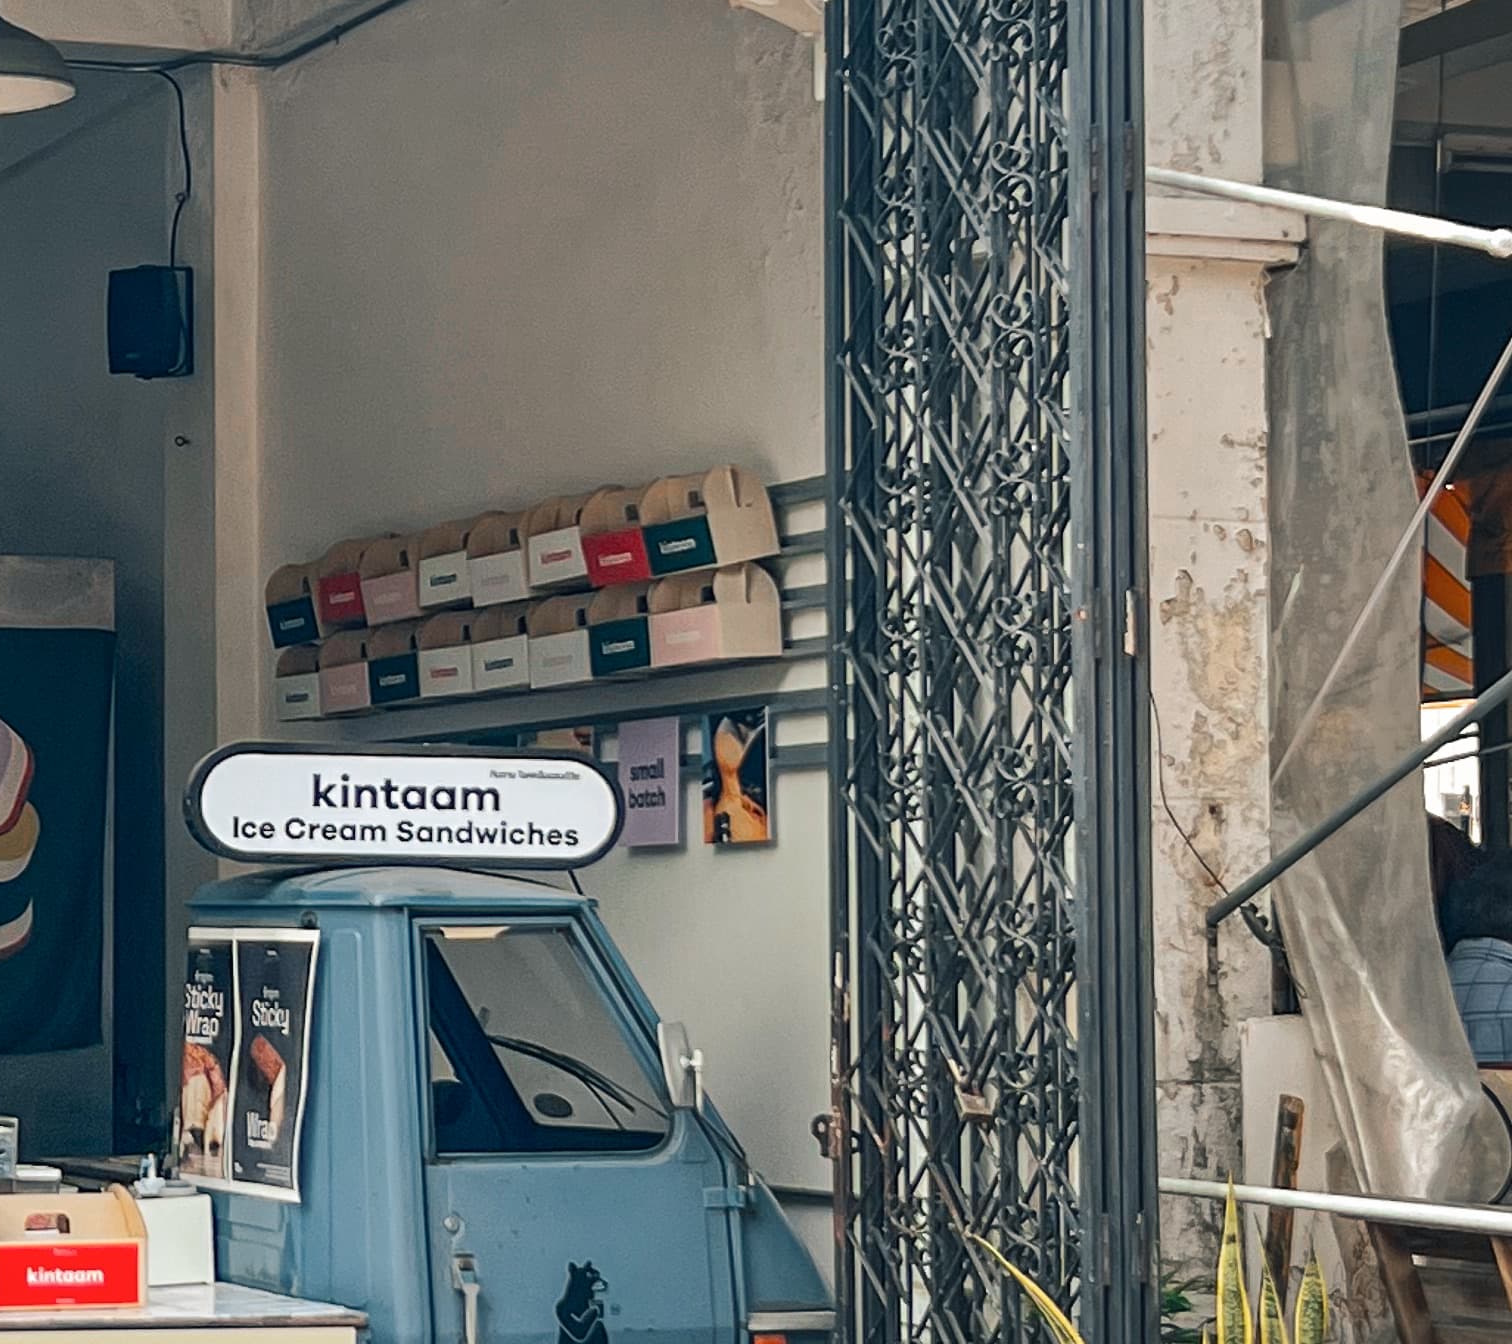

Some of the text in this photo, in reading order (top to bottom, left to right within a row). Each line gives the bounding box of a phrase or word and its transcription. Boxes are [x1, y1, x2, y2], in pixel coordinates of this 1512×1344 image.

[630, 758, 664, 781] small
[312, 774, 500, 811] kintaam
[629, 786, 665, 809] batch
[233, 816, 579, 846] Ice Cream Sandwiches
[252, 1000, 289, 1035] Sticky
[27, 1267, 104, 1284] kintaam
